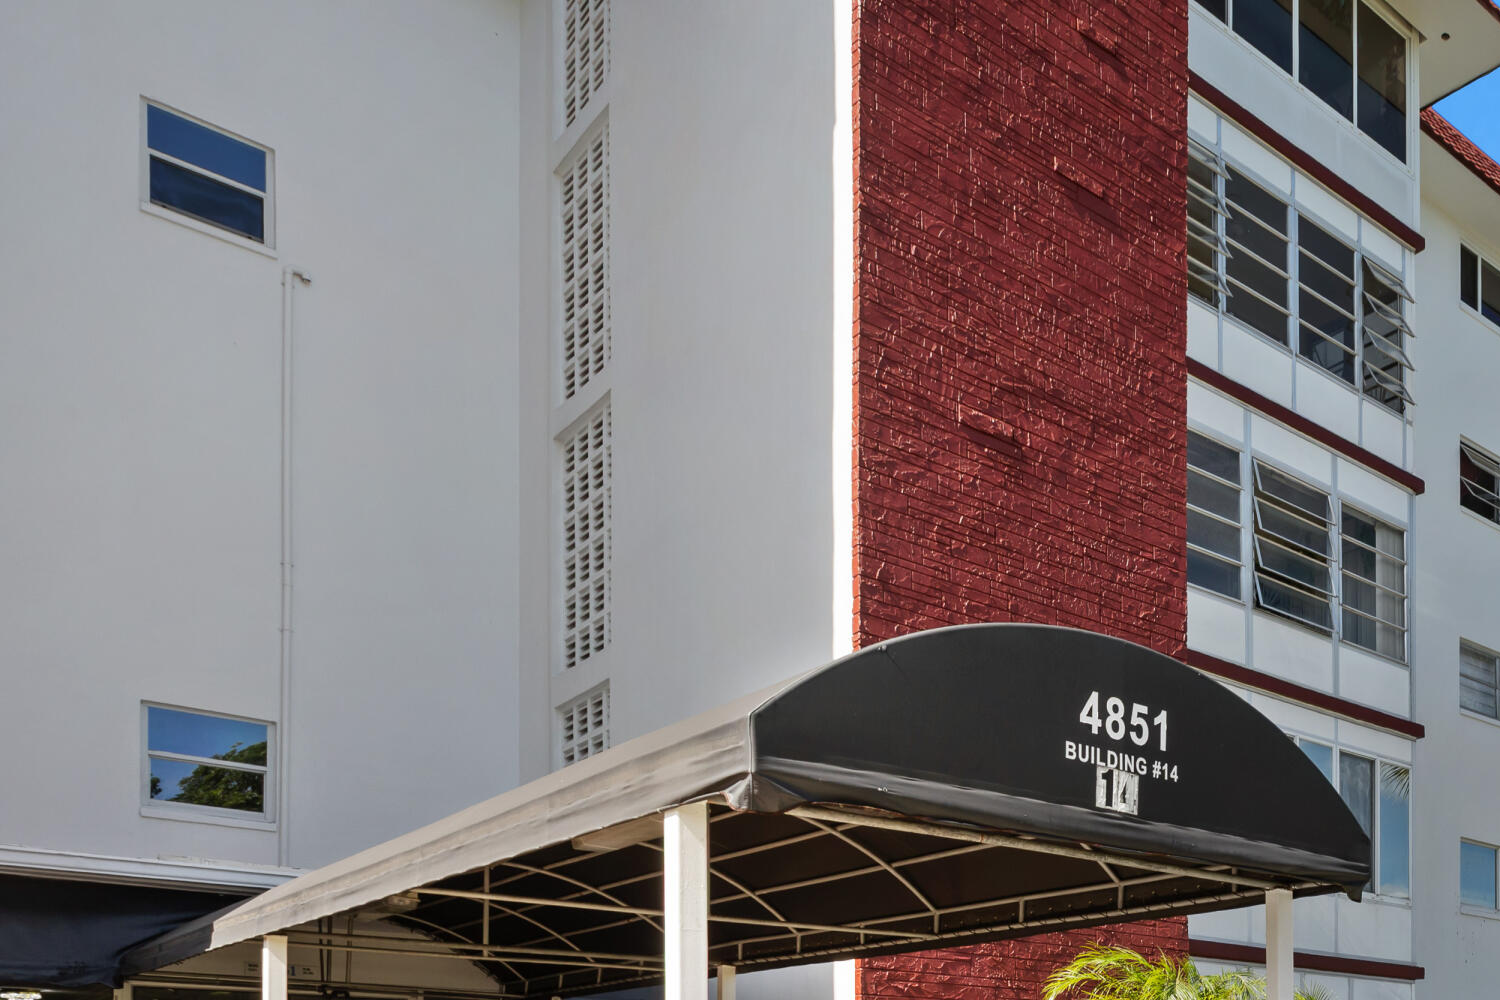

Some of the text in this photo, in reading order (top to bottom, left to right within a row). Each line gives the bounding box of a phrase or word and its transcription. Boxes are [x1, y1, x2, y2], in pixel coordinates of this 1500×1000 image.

[1079, 690, 1167, 752] 4851
[1065, 740, 1179, 783] BUILDING #14
